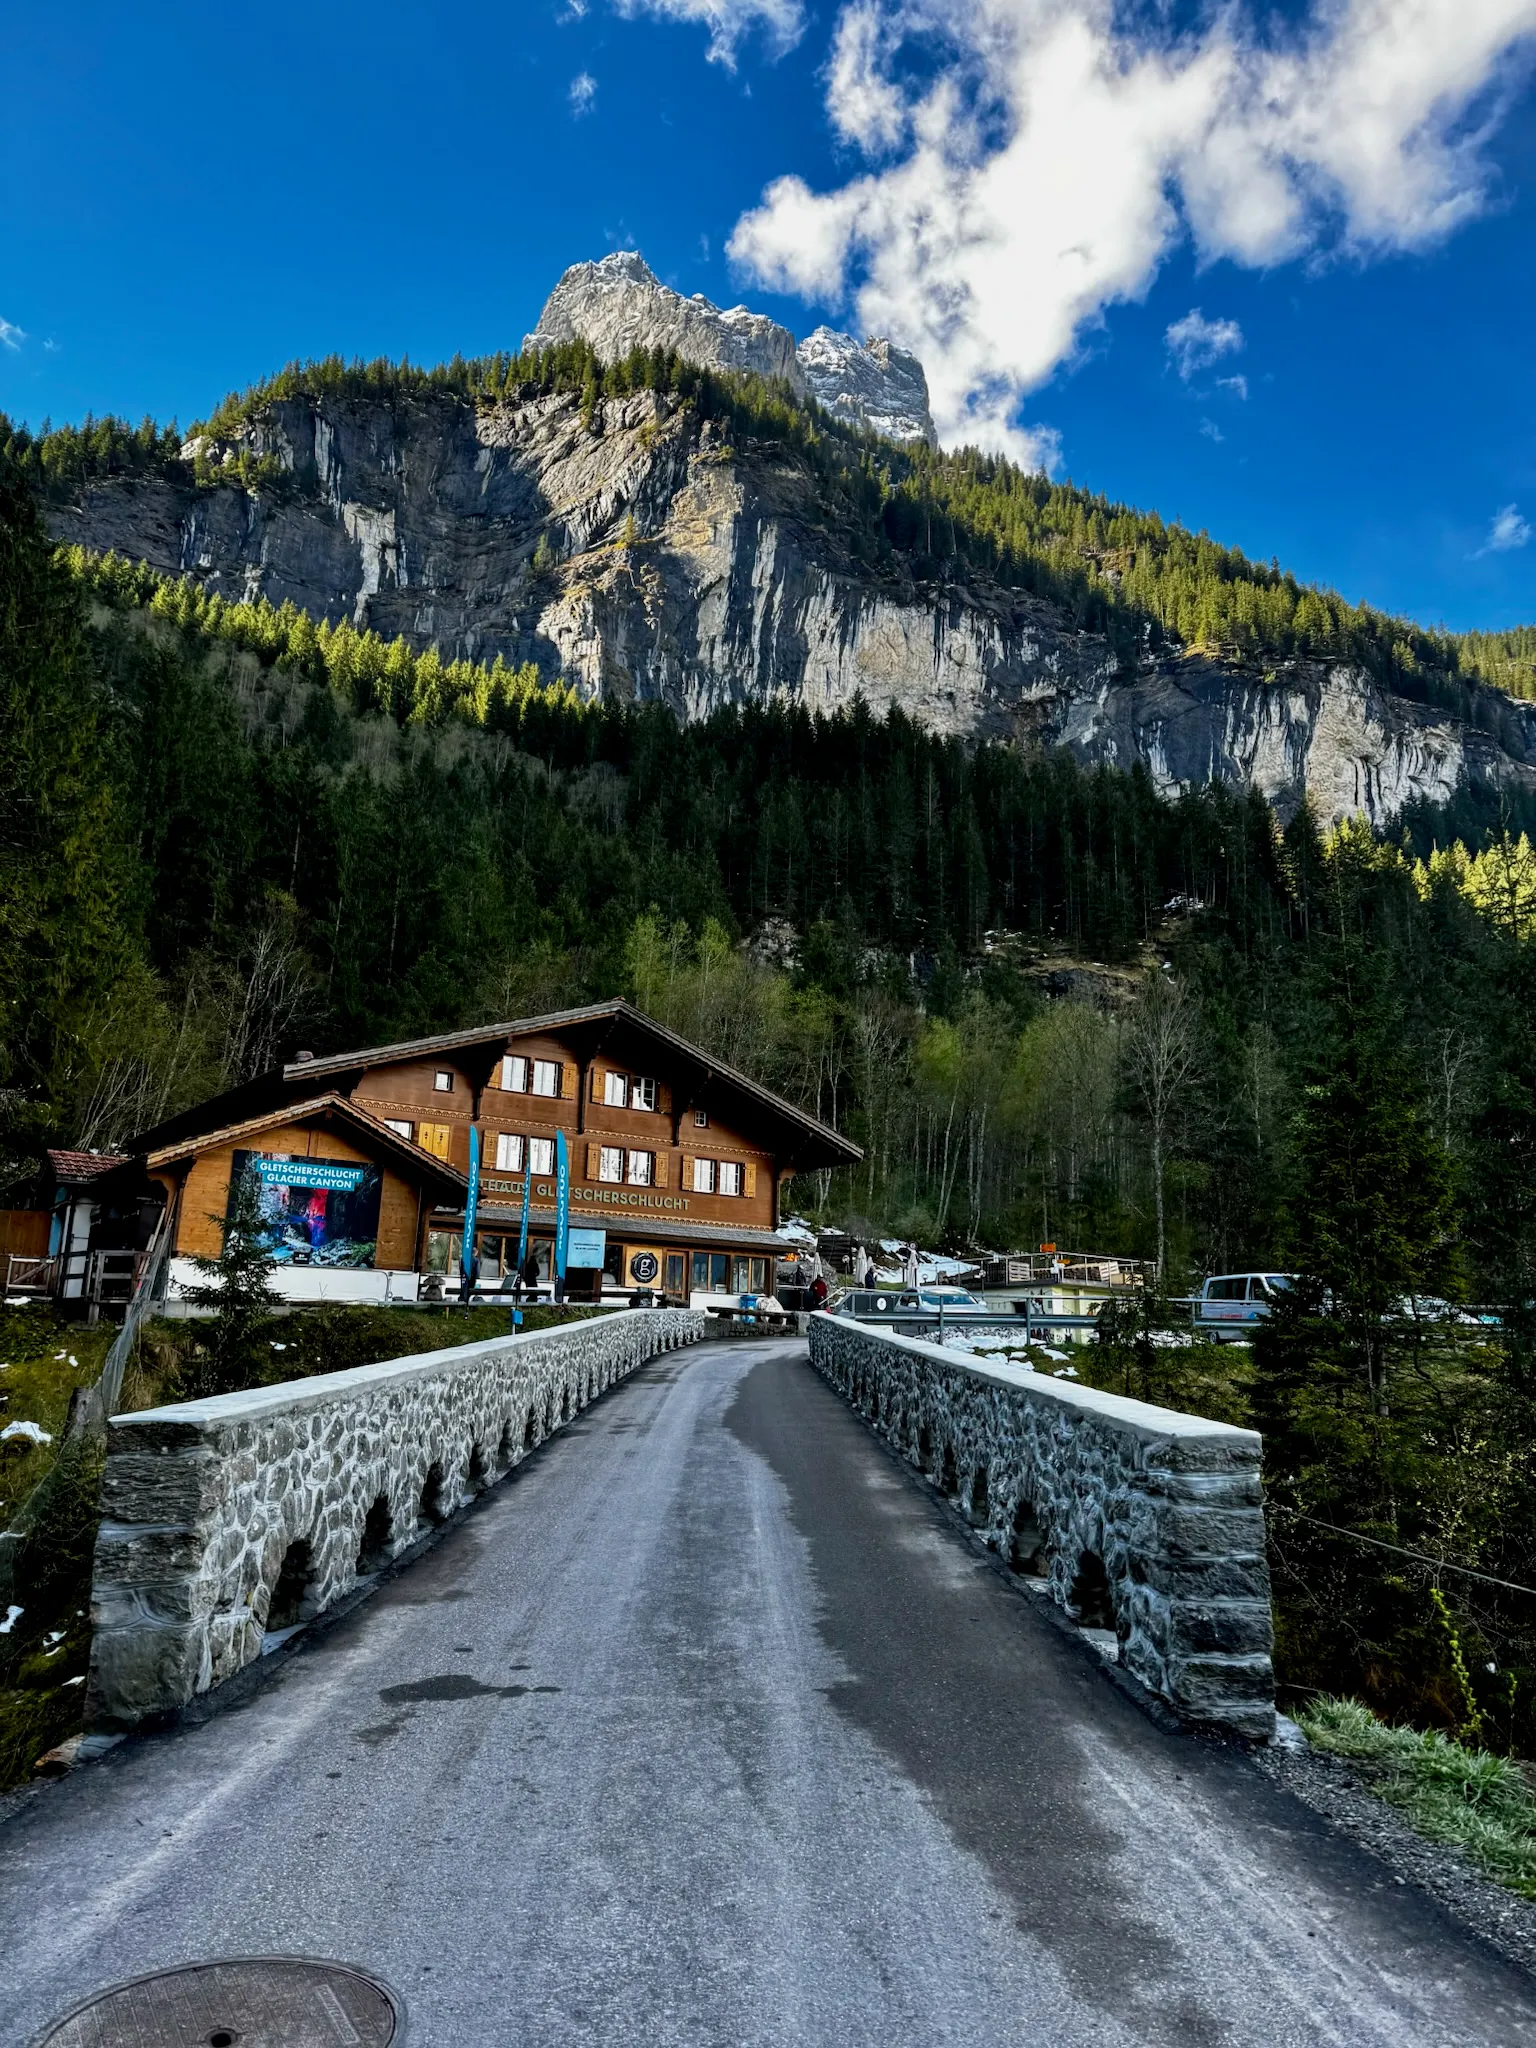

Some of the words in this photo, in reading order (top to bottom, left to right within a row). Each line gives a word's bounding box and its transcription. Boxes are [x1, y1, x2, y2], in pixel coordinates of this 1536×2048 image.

[260, 1162, 360, 1179] GLETSCHERSCHLUCHT
[267, 1173, 307, 1184] GLACIER
[309, 1178, 352, 1188] CANYON
[536, 1184, 690, 1210] GLTSCHERSCHLUCHT
